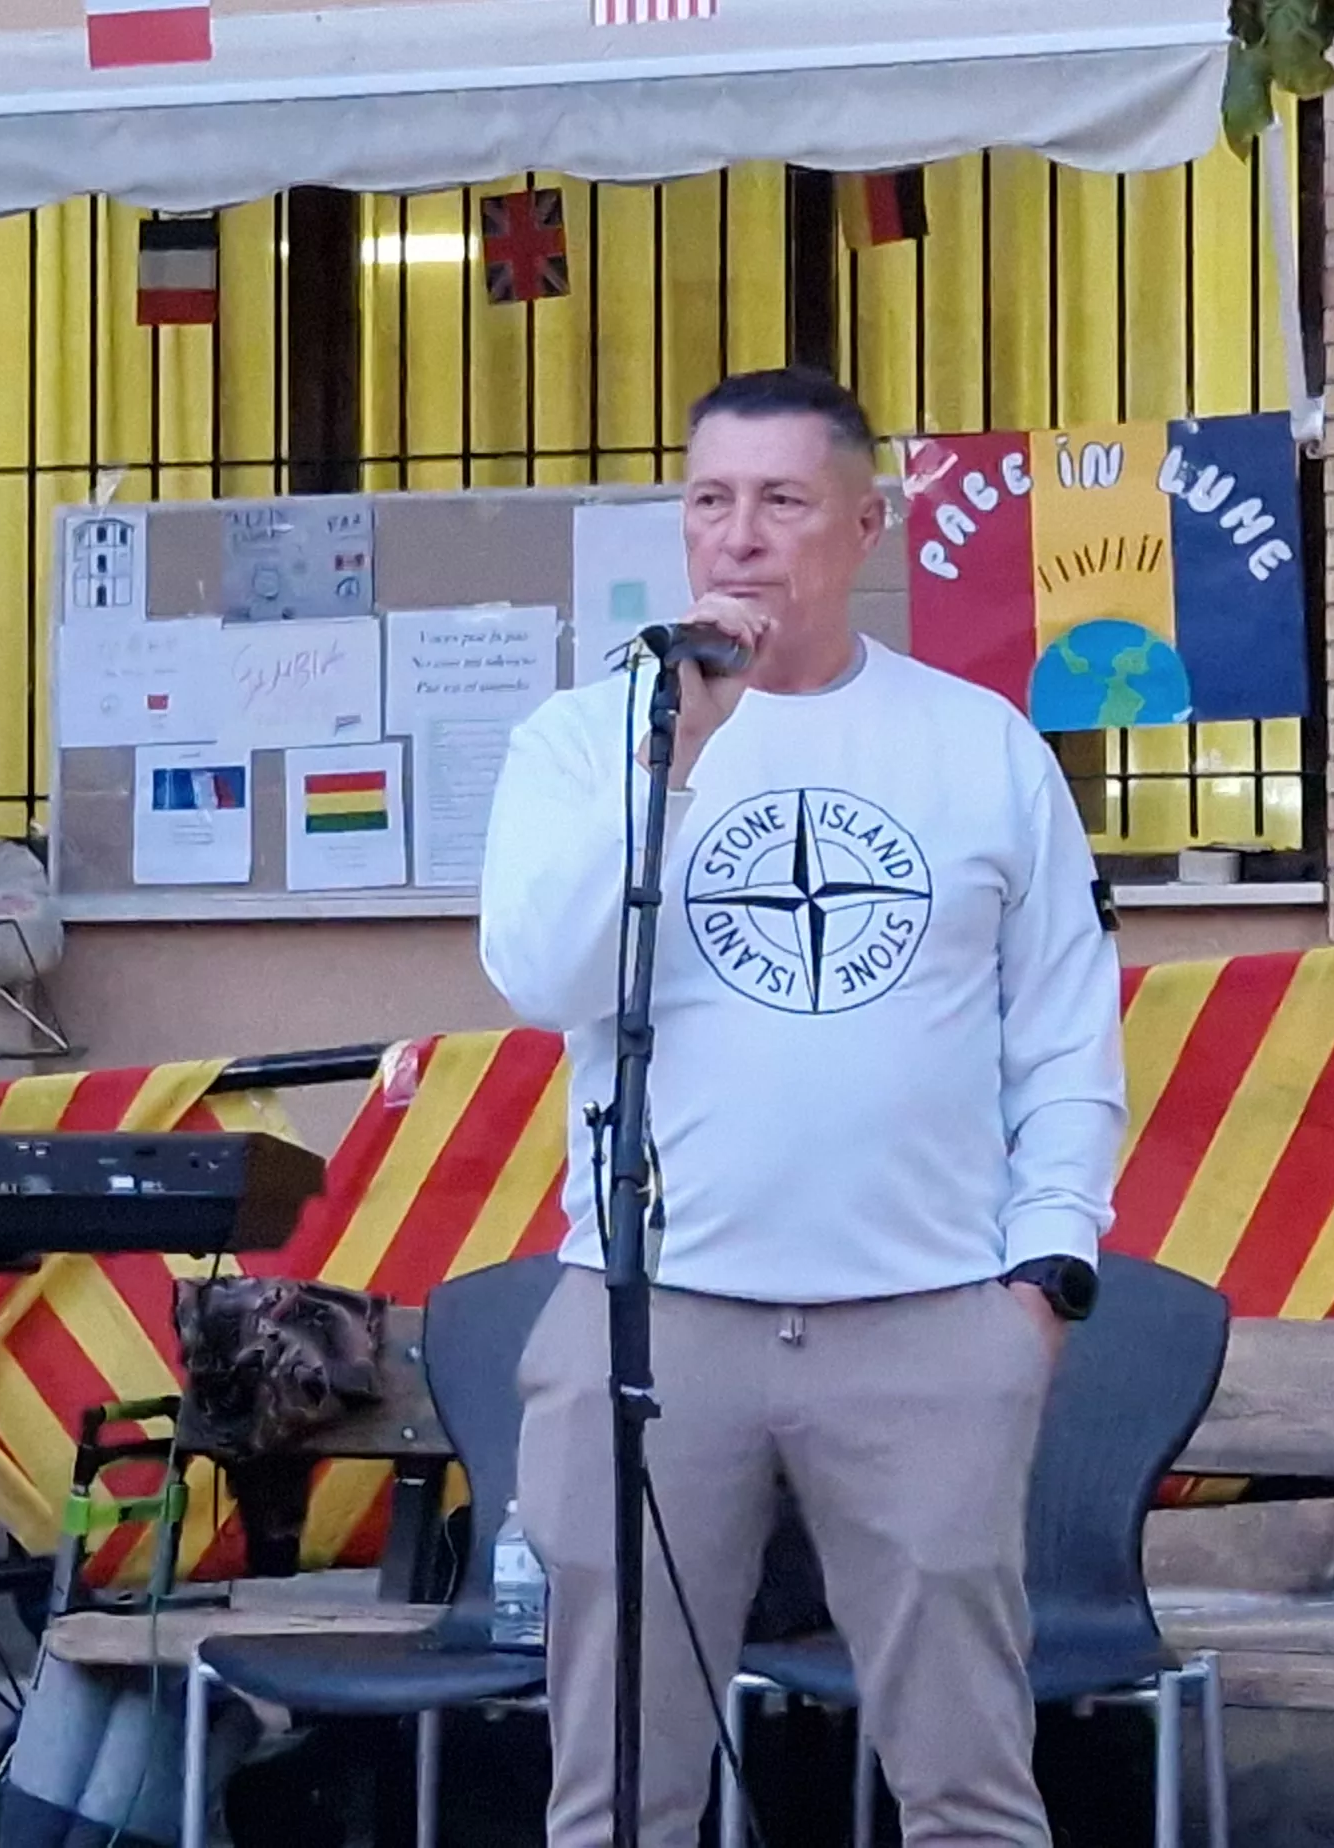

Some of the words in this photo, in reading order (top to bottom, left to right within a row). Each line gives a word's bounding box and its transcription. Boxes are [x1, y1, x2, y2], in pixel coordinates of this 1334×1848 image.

[1158, 445, 1294, 582] LUME
[705, 804, 785, 879] STONE
[819, 802, 914, 880] ISLAND
[705, 910, 796, 997] ISLAND
[835, 912, 914, 995] STONE
